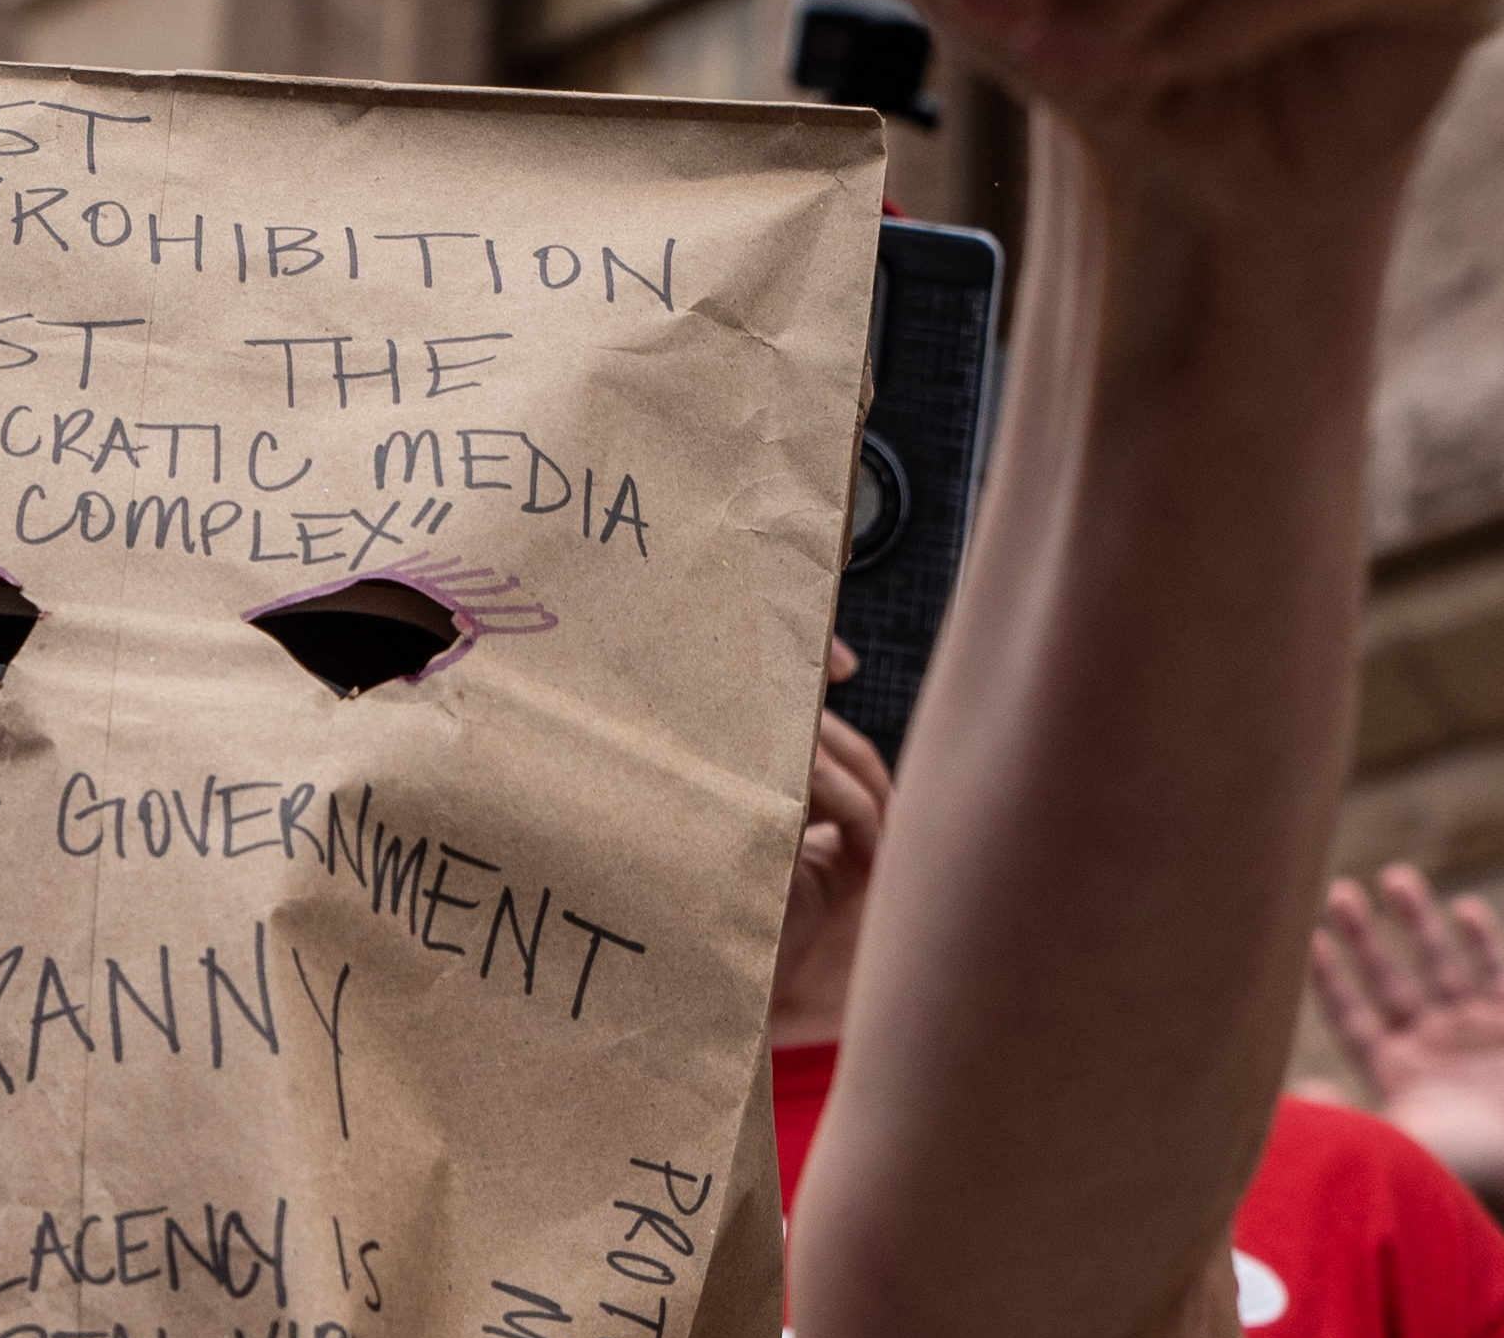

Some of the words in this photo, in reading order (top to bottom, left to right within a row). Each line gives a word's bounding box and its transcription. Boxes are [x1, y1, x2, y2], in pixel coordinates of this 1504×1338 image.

[244, 333, 512, 410] THE
[15, 483, 453, 571] COMPLEX"
[374, 429, 648, 558] MEDIA
[57, 772, 644, 1019] GOVERNMENT
[332, 1214, 383, 1312] IS
